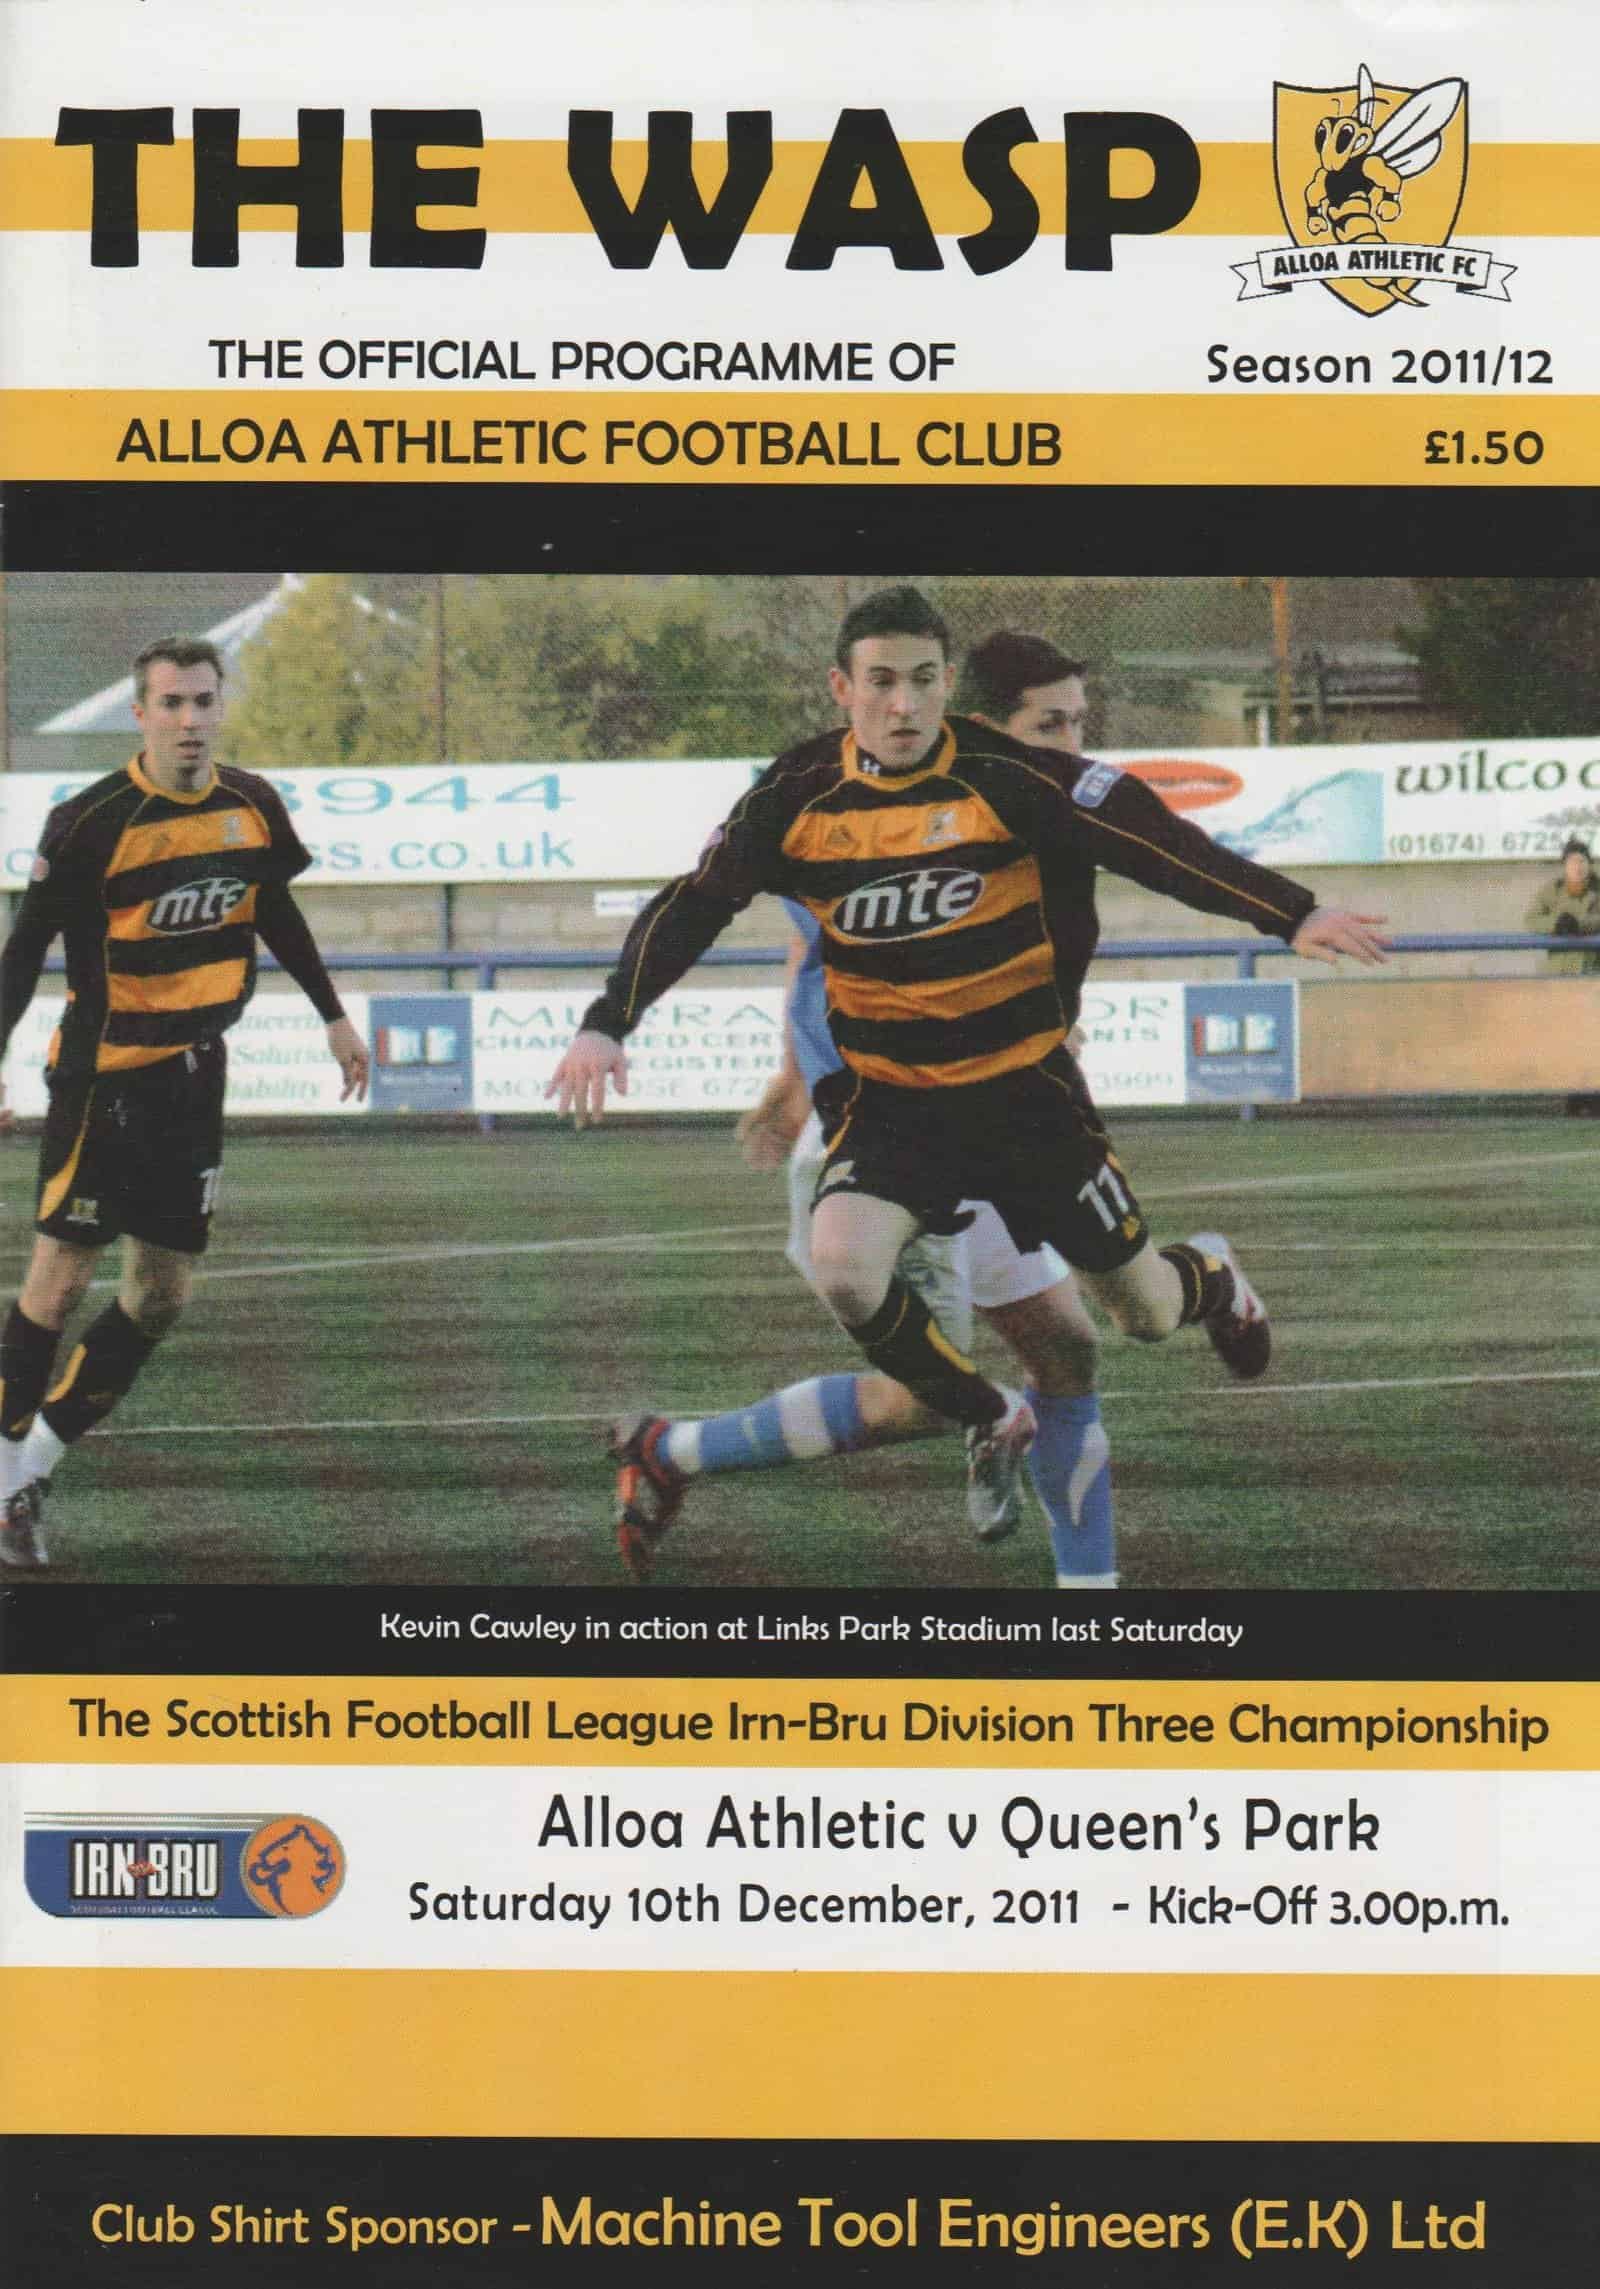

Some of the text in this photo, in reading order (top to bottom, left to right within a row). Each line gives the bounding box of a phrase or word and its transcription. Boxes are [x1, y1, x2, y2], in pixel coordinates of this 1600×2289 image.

[55, 106, 1201, 276] THE WASP
[1273, 250, 1477, 277] ALLOA ATHLETIC FC
[209, 340, 956, 382] THE OFFICIAL PROGRAMME OF
[1208, 344, 1553, 386] Season 2011/12
[117, 419, 1061, 467] ALLOA ATHLETIC FOOTBALL CLUB
[1425, 430, 1544, 465] £1.50
[1395, 748, 1566, 794] wilco
[1390, 833, 1485, 856] (01674)
[842, 869, 979, 931] mte
[1077, 1162, 1129, 1232] 11
[382, 1613, 1243, 1648] Kevin Cawley in action at Links Park Stadium last Saturday
[69, 1698, 1549, 1752] The Scottish Football League Irn-Bru Division Three Championship
[538, 1793, 1380, 1859] Alloa Athletic v Queen's Park
[410, 1881, 1509, 1933] Saturday 10th December, 2011 - Kick-Off 3.00p.m.
[92, 2195, 1486, 2260] Club Shirt Sponsor - Machine Tool Engineers (E.K) Ltd
